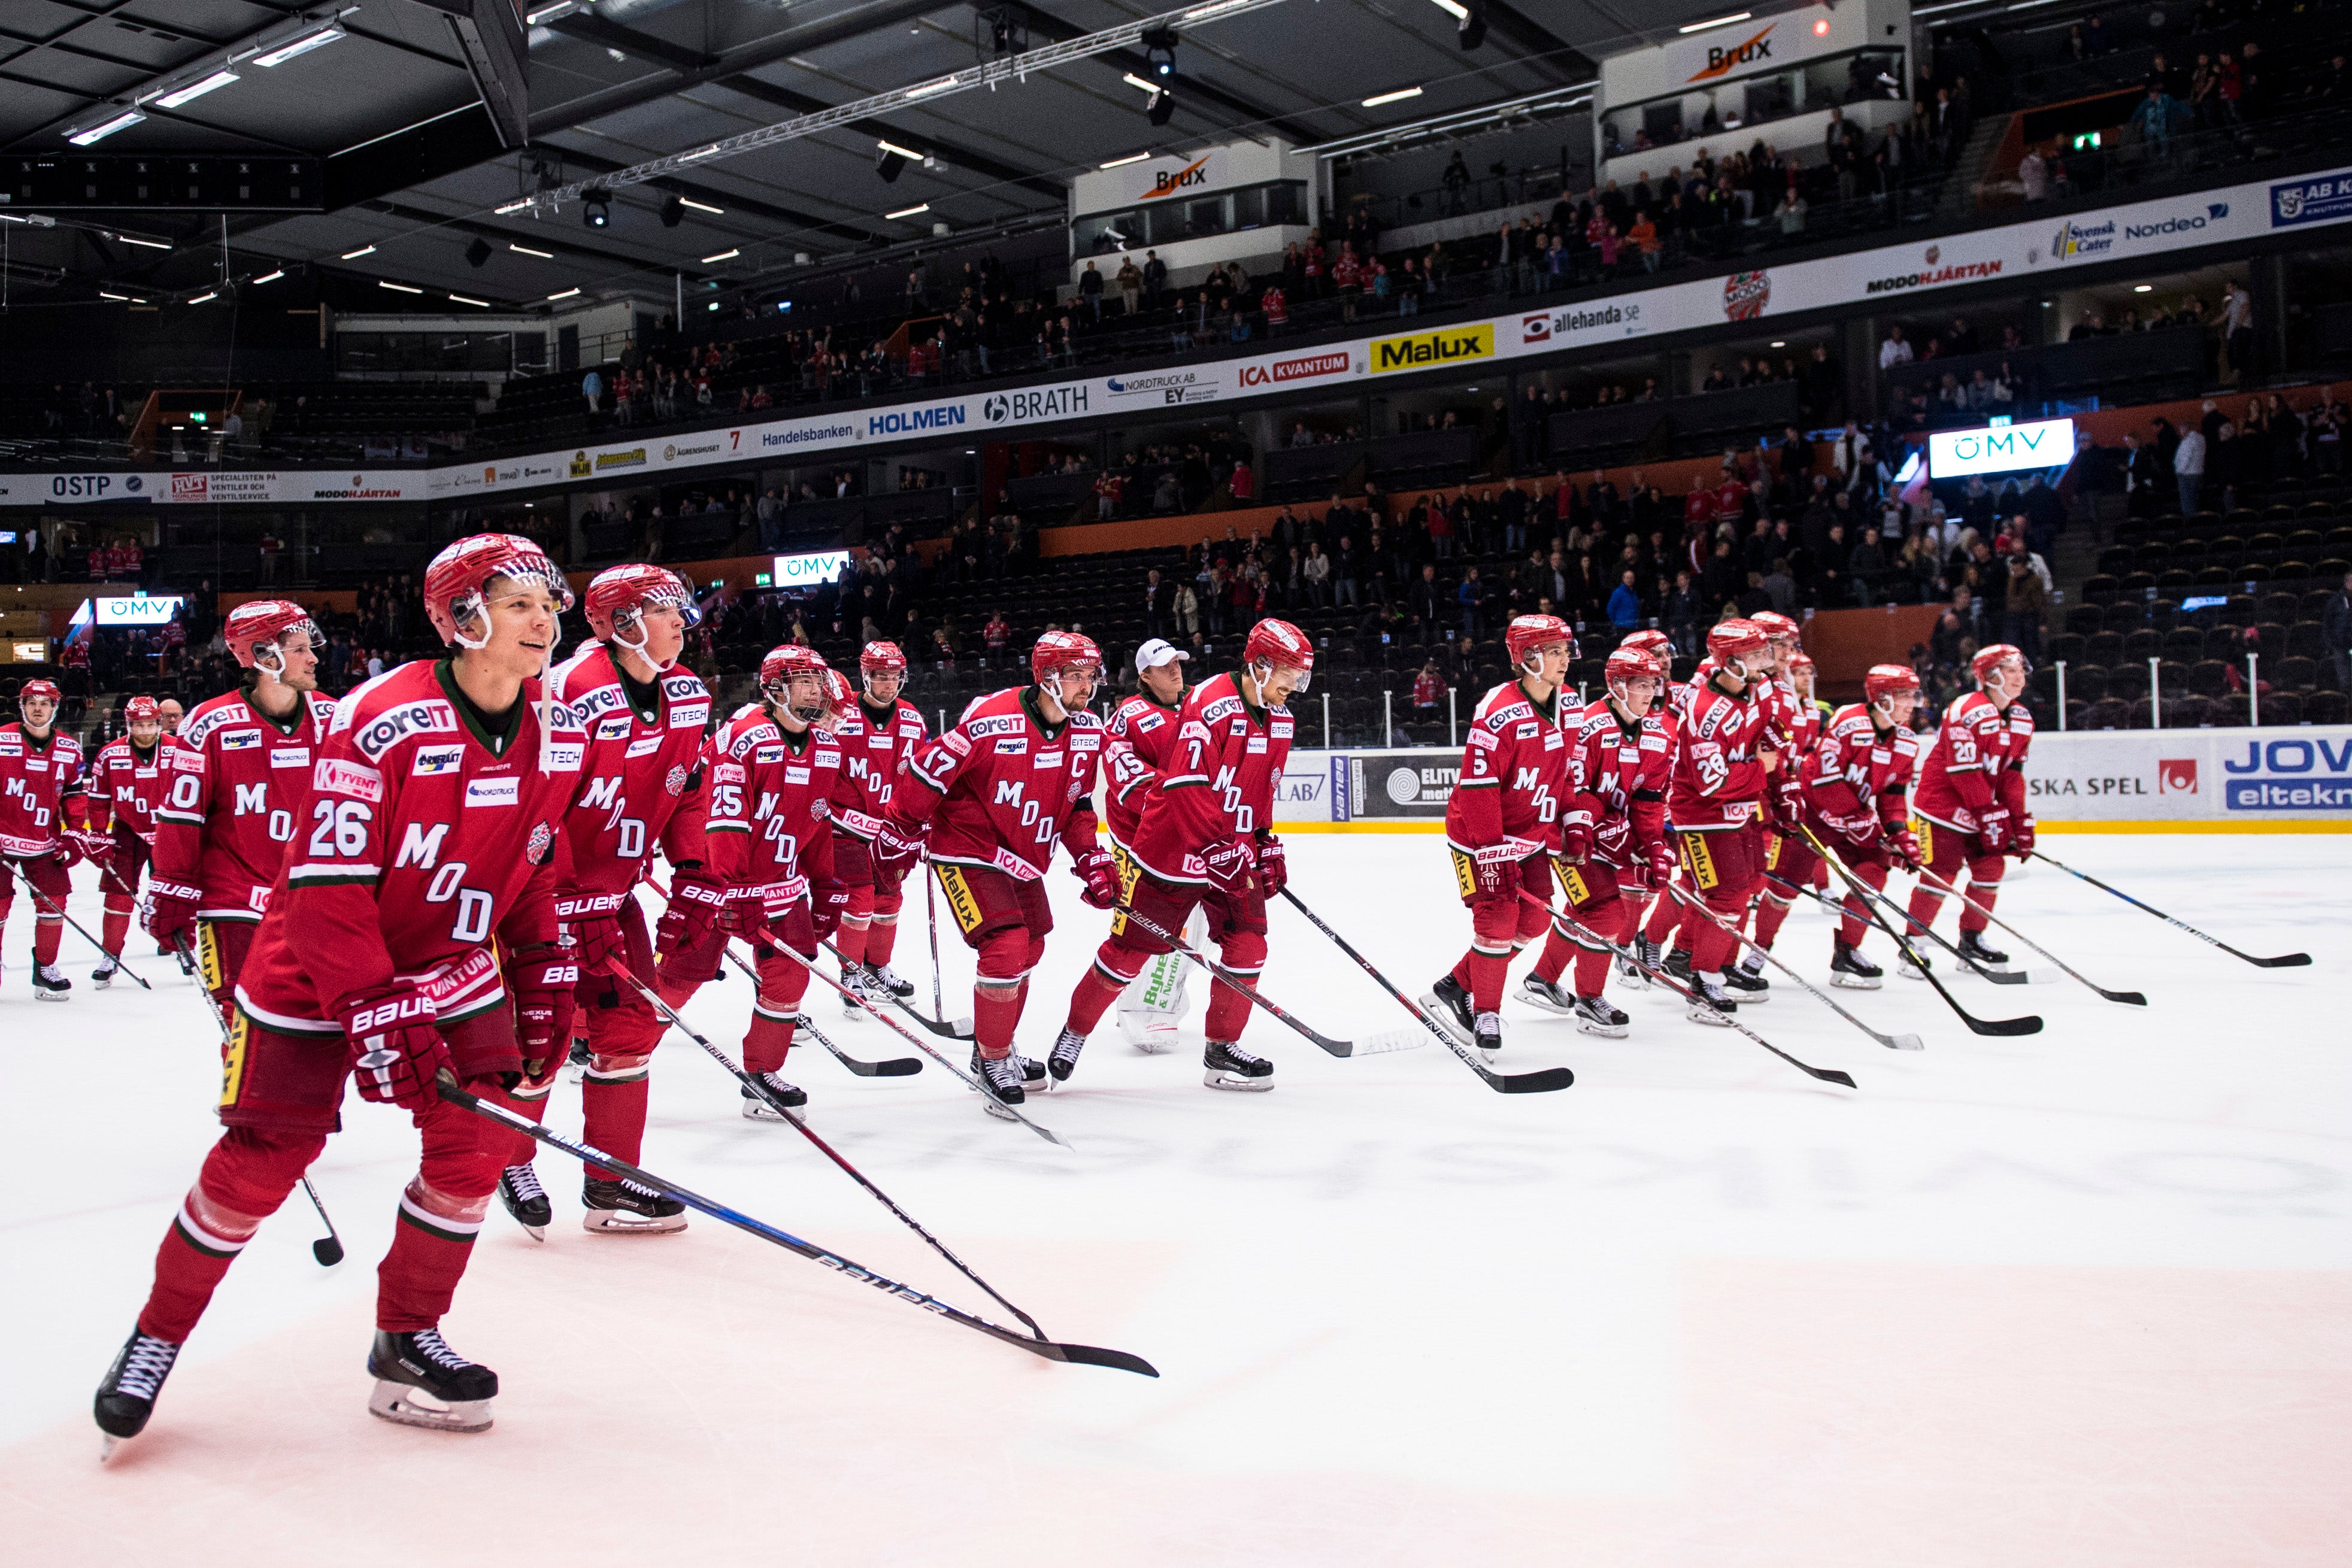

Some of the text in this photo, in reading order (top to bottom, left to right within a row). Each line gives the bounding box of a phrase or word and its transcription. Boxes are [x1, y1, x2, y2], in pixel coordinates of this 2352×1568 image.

[1708, 38, 1772, 71] Brux
[1156, 168, 1206, 190] Brux
[2306, 183, 2333, 199] AB
[2071, 220, 2115, 238] Svensk
[2125, 217, 2206, 239] Nordea
[2077, 238, 2113, 254] Cater
[1381, 335, 1481, 368] Malux
[1125, 373, 1195, 391] NORDTRUCK AB
[1239, 356, 1345, 387] ICA KVANTUM
[1014, 386, 1088, 419] BRATH
[1165, 387, 1185, 404] EY
[869, 405, 965, 435] HOLMEN
[730, 430, 740, 450] 7
[763, 426, 852, 446] Handelsbanken
[1956, 429, 2045, 459] ÖMV
[53, 476, 110, 496] OSTP
[787, 557, 835, 576] ÖMV
[111, 601, 166, 615] ÖMV
[574, 689, 625, 721] oreIT
[672, 709, 706, 723] EITECH
[1204, 699, 1243, 721] coreIT
[189, 705, 245, 746] coreIT
[969, 718, 1023, 737] coreIT
[1116, 700, 1147, 736] coreIT
[1489, 704, 1530, 730] coreIT
[361, 705, 450, 756] coreIT
[901, 727, 919, 736] EITECH
[1272, 726, 1292, 735] EITECH
[734, 726, 777, 759] coreIT
[902, 739, 913, 757] A
[1641, 738, 1665, 748] EITECH
[1953, 742, 1977, 763] 20
[551, 751, 581, 763] TECH
[816, 756, 839, 764] EITECH
[923, 745, 956, 777] 17
[1071, 752, 1088, 778] C
[1188, 741, 1201, 769] 7
[1474, 748, 1487, 776] 5
[55, 763, 65, 780] A
[1114, 753, 1144, 783] 45
[1697, 752, 1726, 785] 28
[479, 787, 515, 796] NORDTRUCK
[1289, 783, 1313, 801] AB
[2030, 778, 2148, 796] SKA SPEL
[711, 785, 743, 817] 25
[1725, 804, 1747, 817] ICA
[309, 799, 373, 857] 26
[847, 812, 863, 827] ICA
[999, 850, 1016, 873] ICA
[1687, 833, 1712, 885] Malux
[1454, 851, 1469, 891] alux
[764, 884, 804, 899] VANTUM
[942, 866, 975, 927] Malux
[1307, 913, 1335, 938] BAUER
[1159, 953, 1182, 1009] & Nordin
